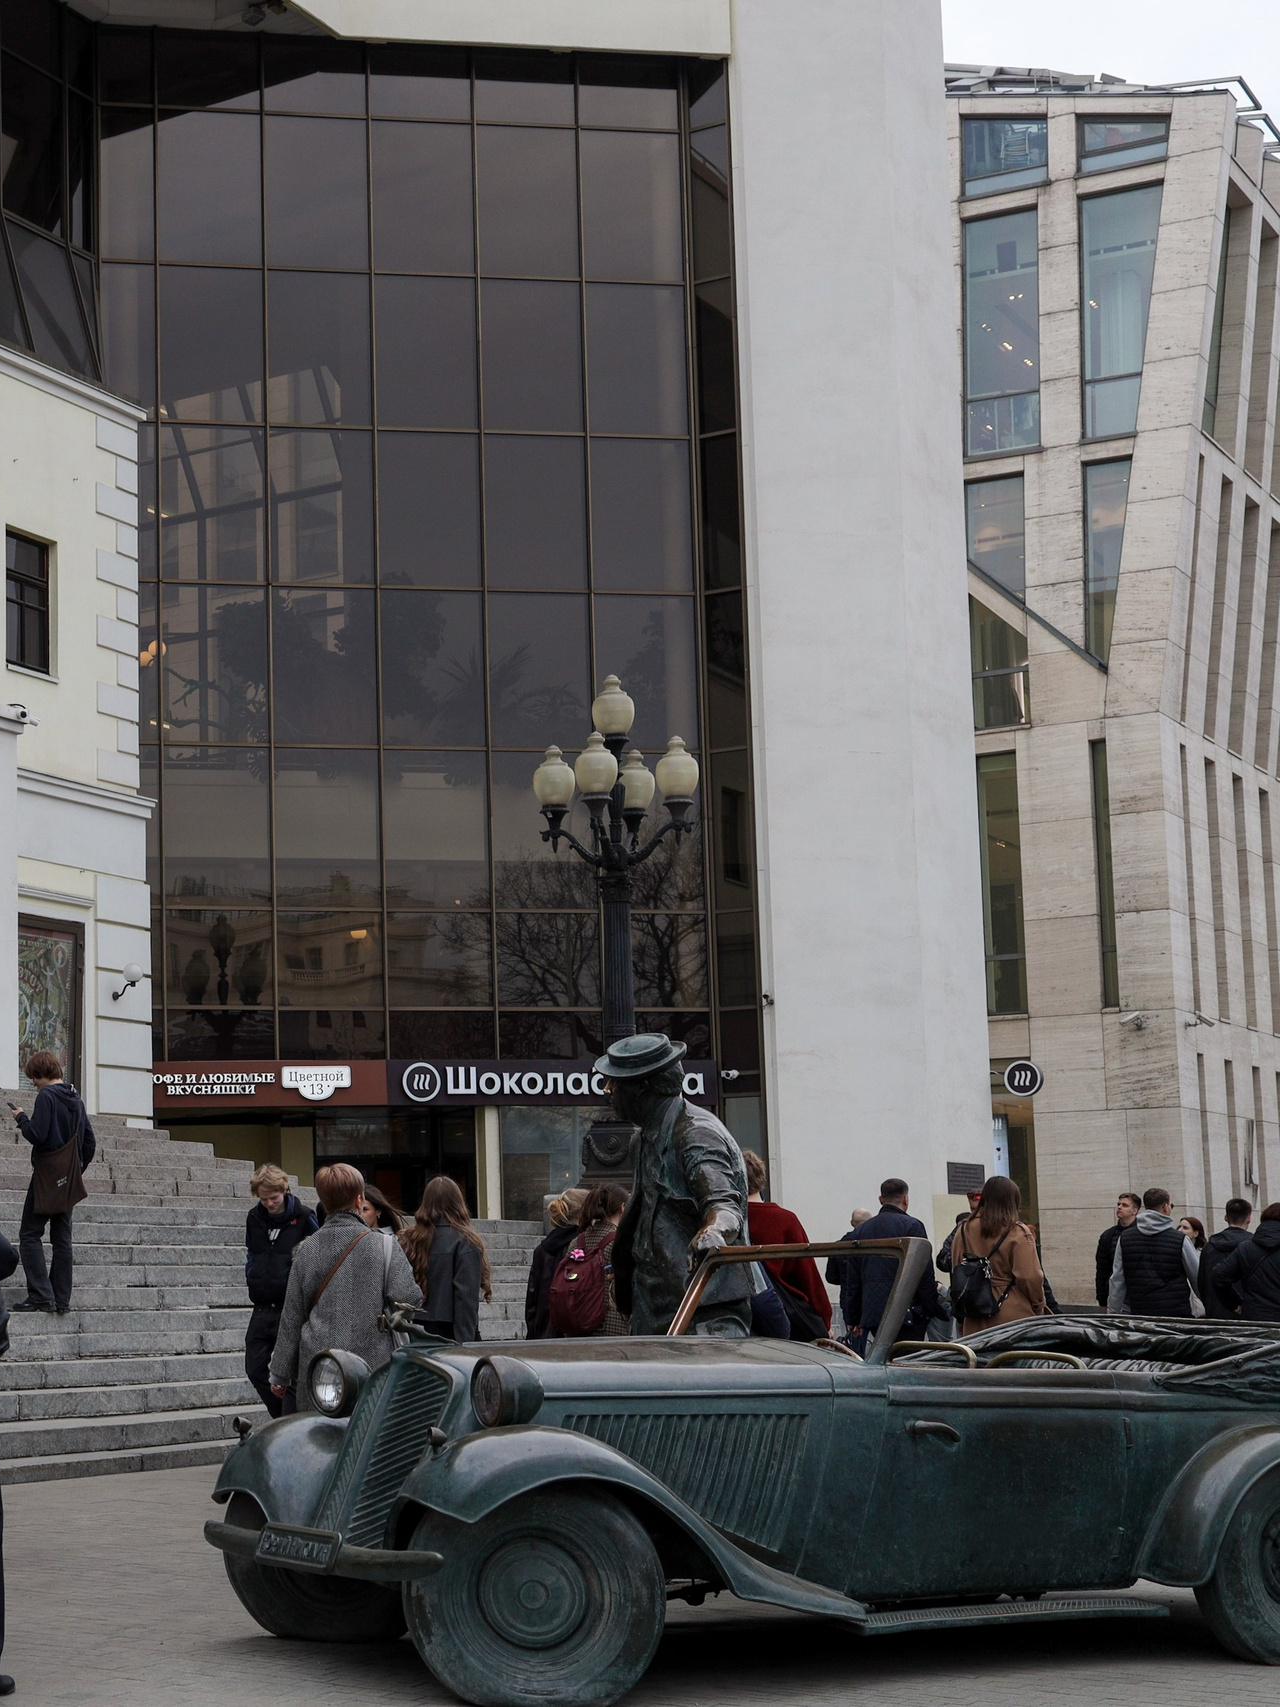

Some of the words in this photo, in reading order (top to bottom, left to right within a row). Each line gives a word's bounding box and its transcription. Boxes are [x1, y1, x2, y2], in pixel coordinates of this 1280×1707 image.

[152, 1073, 183, 1084] ОФЕ
[185, 1073, 197, 1084] И
[199, 1072, 276, 1084] ЛЮБИМЫЕ
[289, 1071, 344, 1083] Цветной
[446, 1066, 705, 1096] Шоколаа
[166, 1084, 256, 1096] ВКУСНЯШКИ
[309, 1084, 324, 1096] 13
